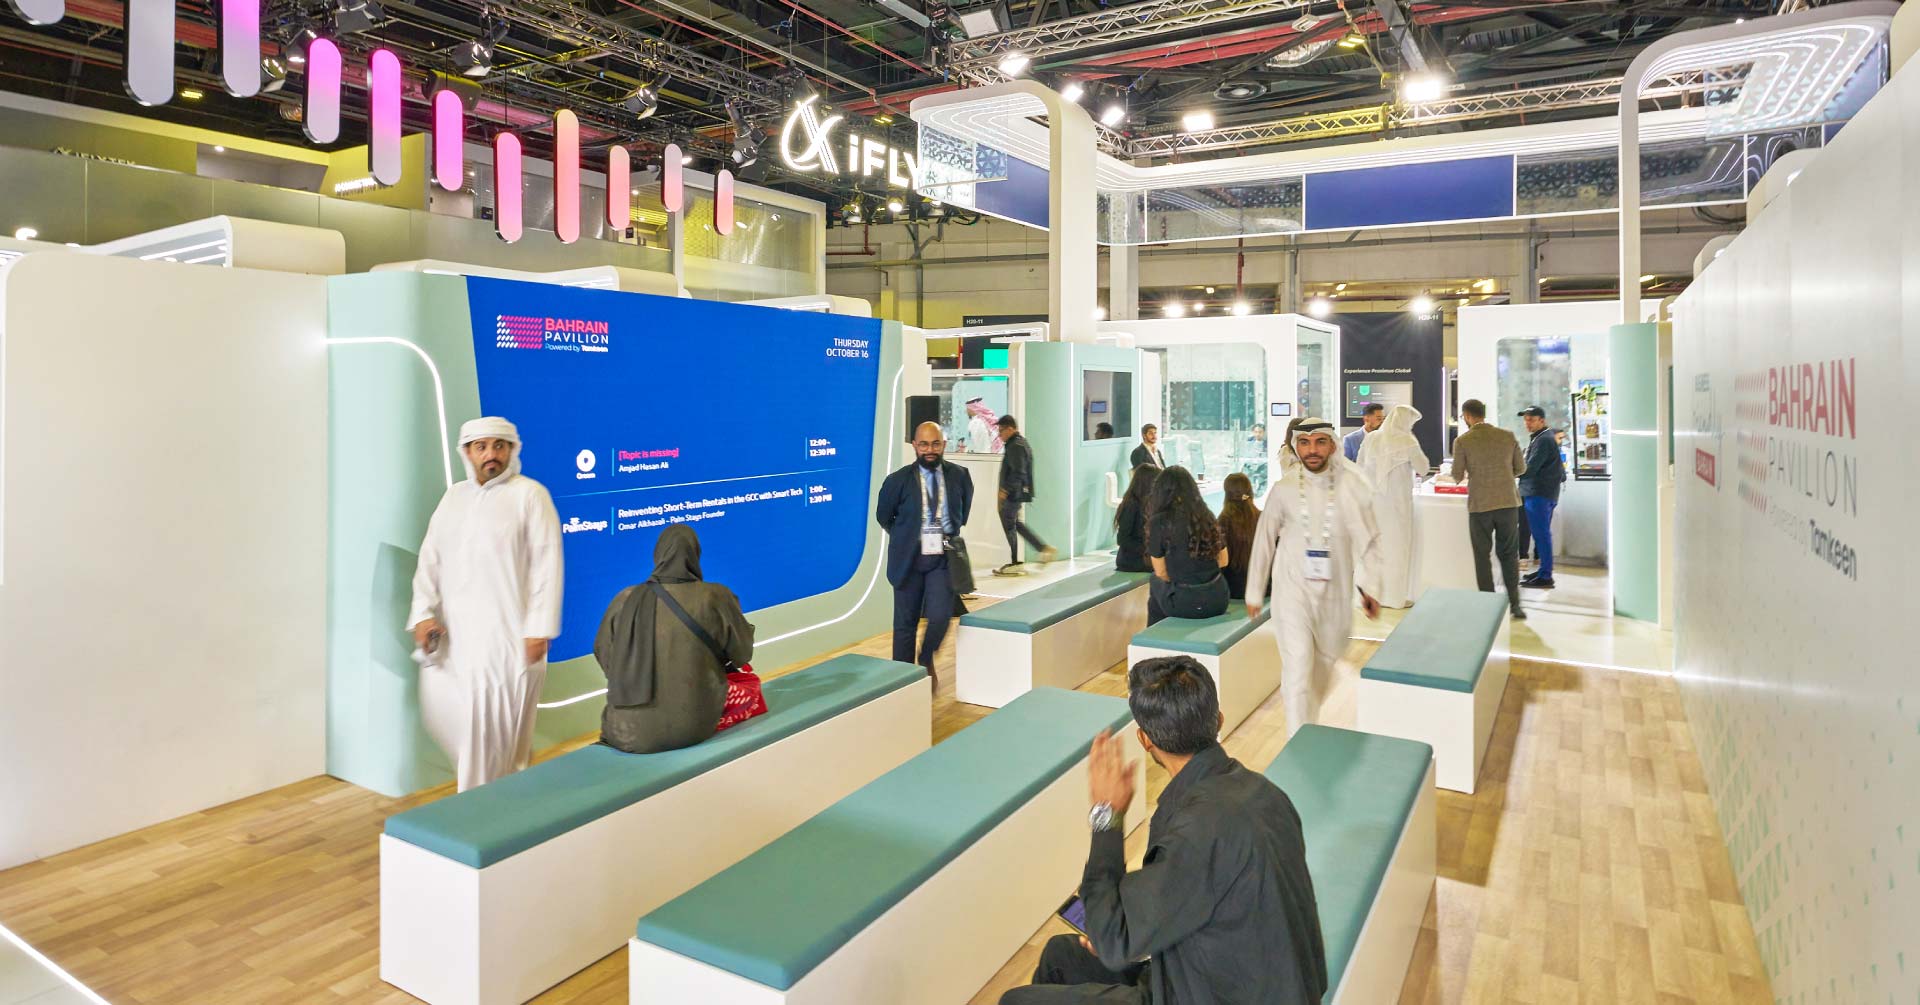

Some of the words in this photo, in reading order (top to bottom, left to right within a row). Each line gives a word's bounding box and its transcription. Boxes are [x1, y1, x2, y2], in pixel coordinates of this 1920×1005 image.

[545, 318, 608, 333] BAHRAIN
[545, 331, 608, 344] PAVILION
[834, 338, 869, 348] THURSDAY
[545, 343, 572, 351] Powered
[826, 348, 860, 358] OCTOBER
[861, 350, 869, 359] 16
[1769, 358, 1856, 439] BAHRAIN
[809, 449, 826, 457] 12:30
[1768, 436, 1857, 518] PAVILION
[619, 506, 663, 518] Reinventing
[664, 500, 702, 512] Short-Term
[703, 497, 727, 507] Rentals
[728, 496, 733, 505] in
[734, 494, 744, 503] the
[745, 492, 759, 501] GCC
[772, 490, 790, 499] Smart
[790, 488, 803, 496] Tech
[618, 522, 638, 531] Omar
[702, 511, 725, 519] Founder
[1809, 518, 1857, 581] Tamkeen
